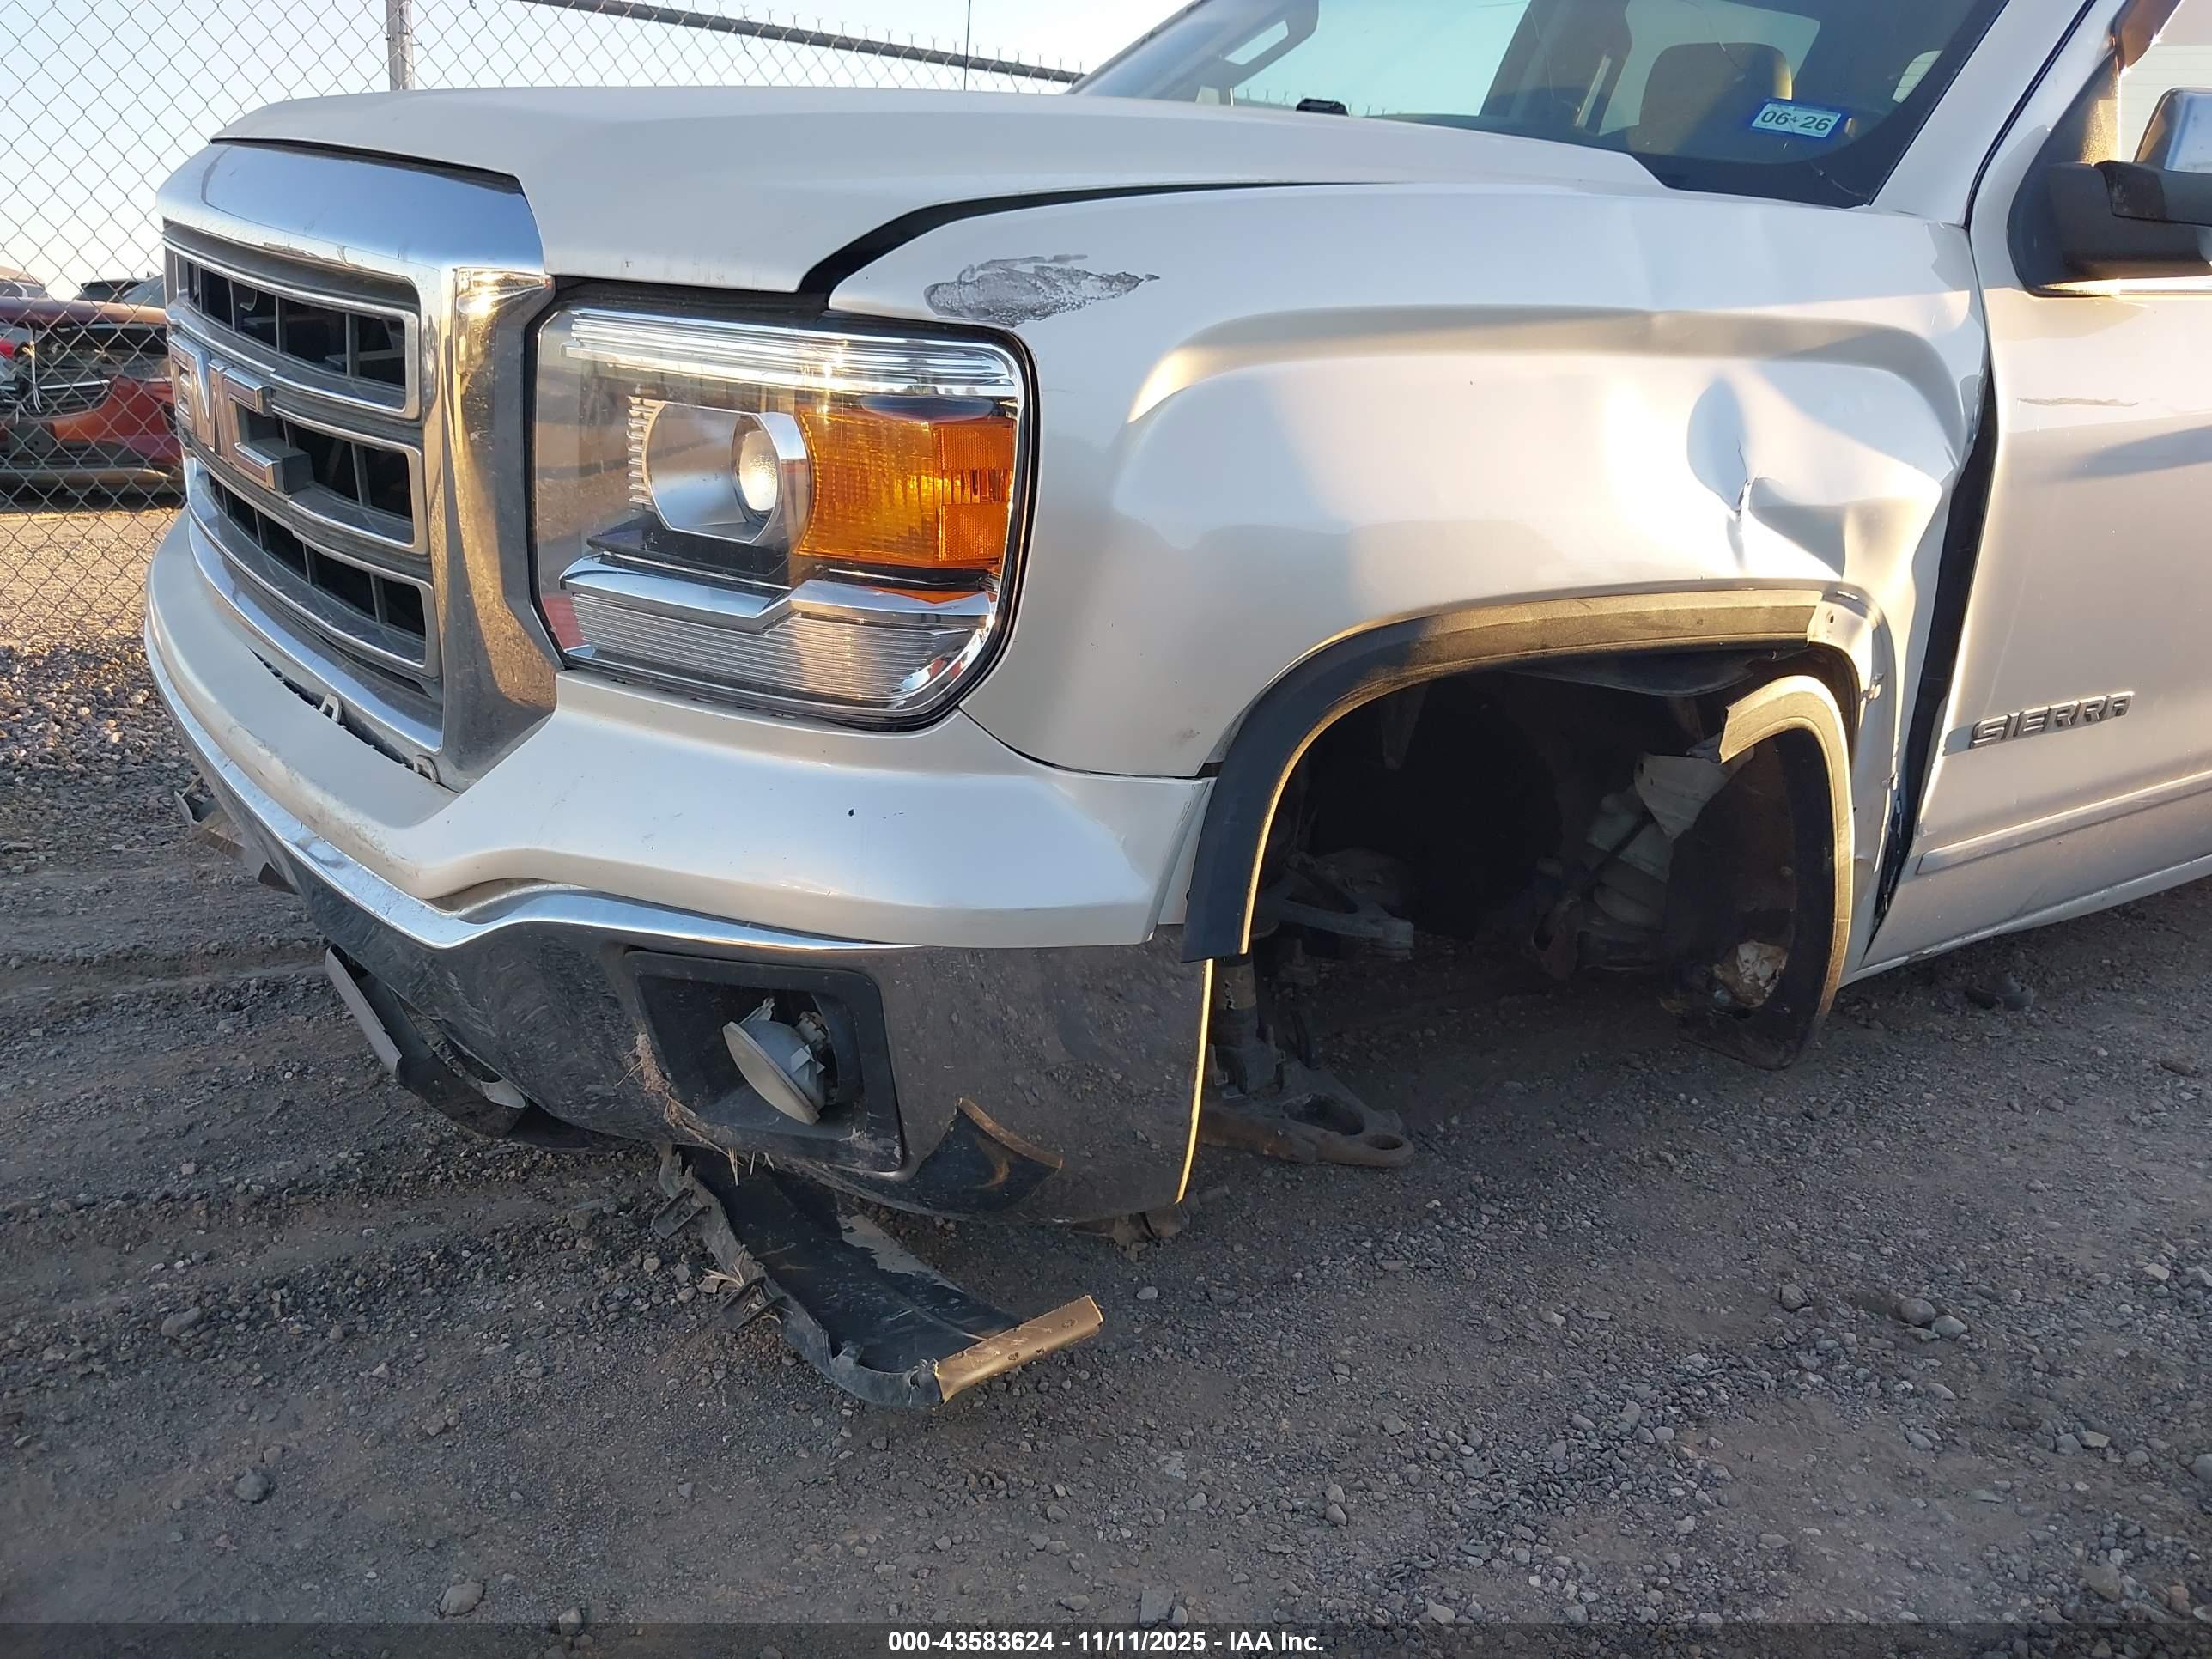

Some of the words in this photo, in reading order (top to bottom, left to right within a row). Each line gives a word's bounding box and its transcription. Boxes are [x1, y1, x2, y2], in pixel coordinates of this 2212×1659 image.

[1761, 111, 1791, 125] 06
[1799, 116, 1832, 131] 26
[1970, 690, 2136, 749] SIERRA
